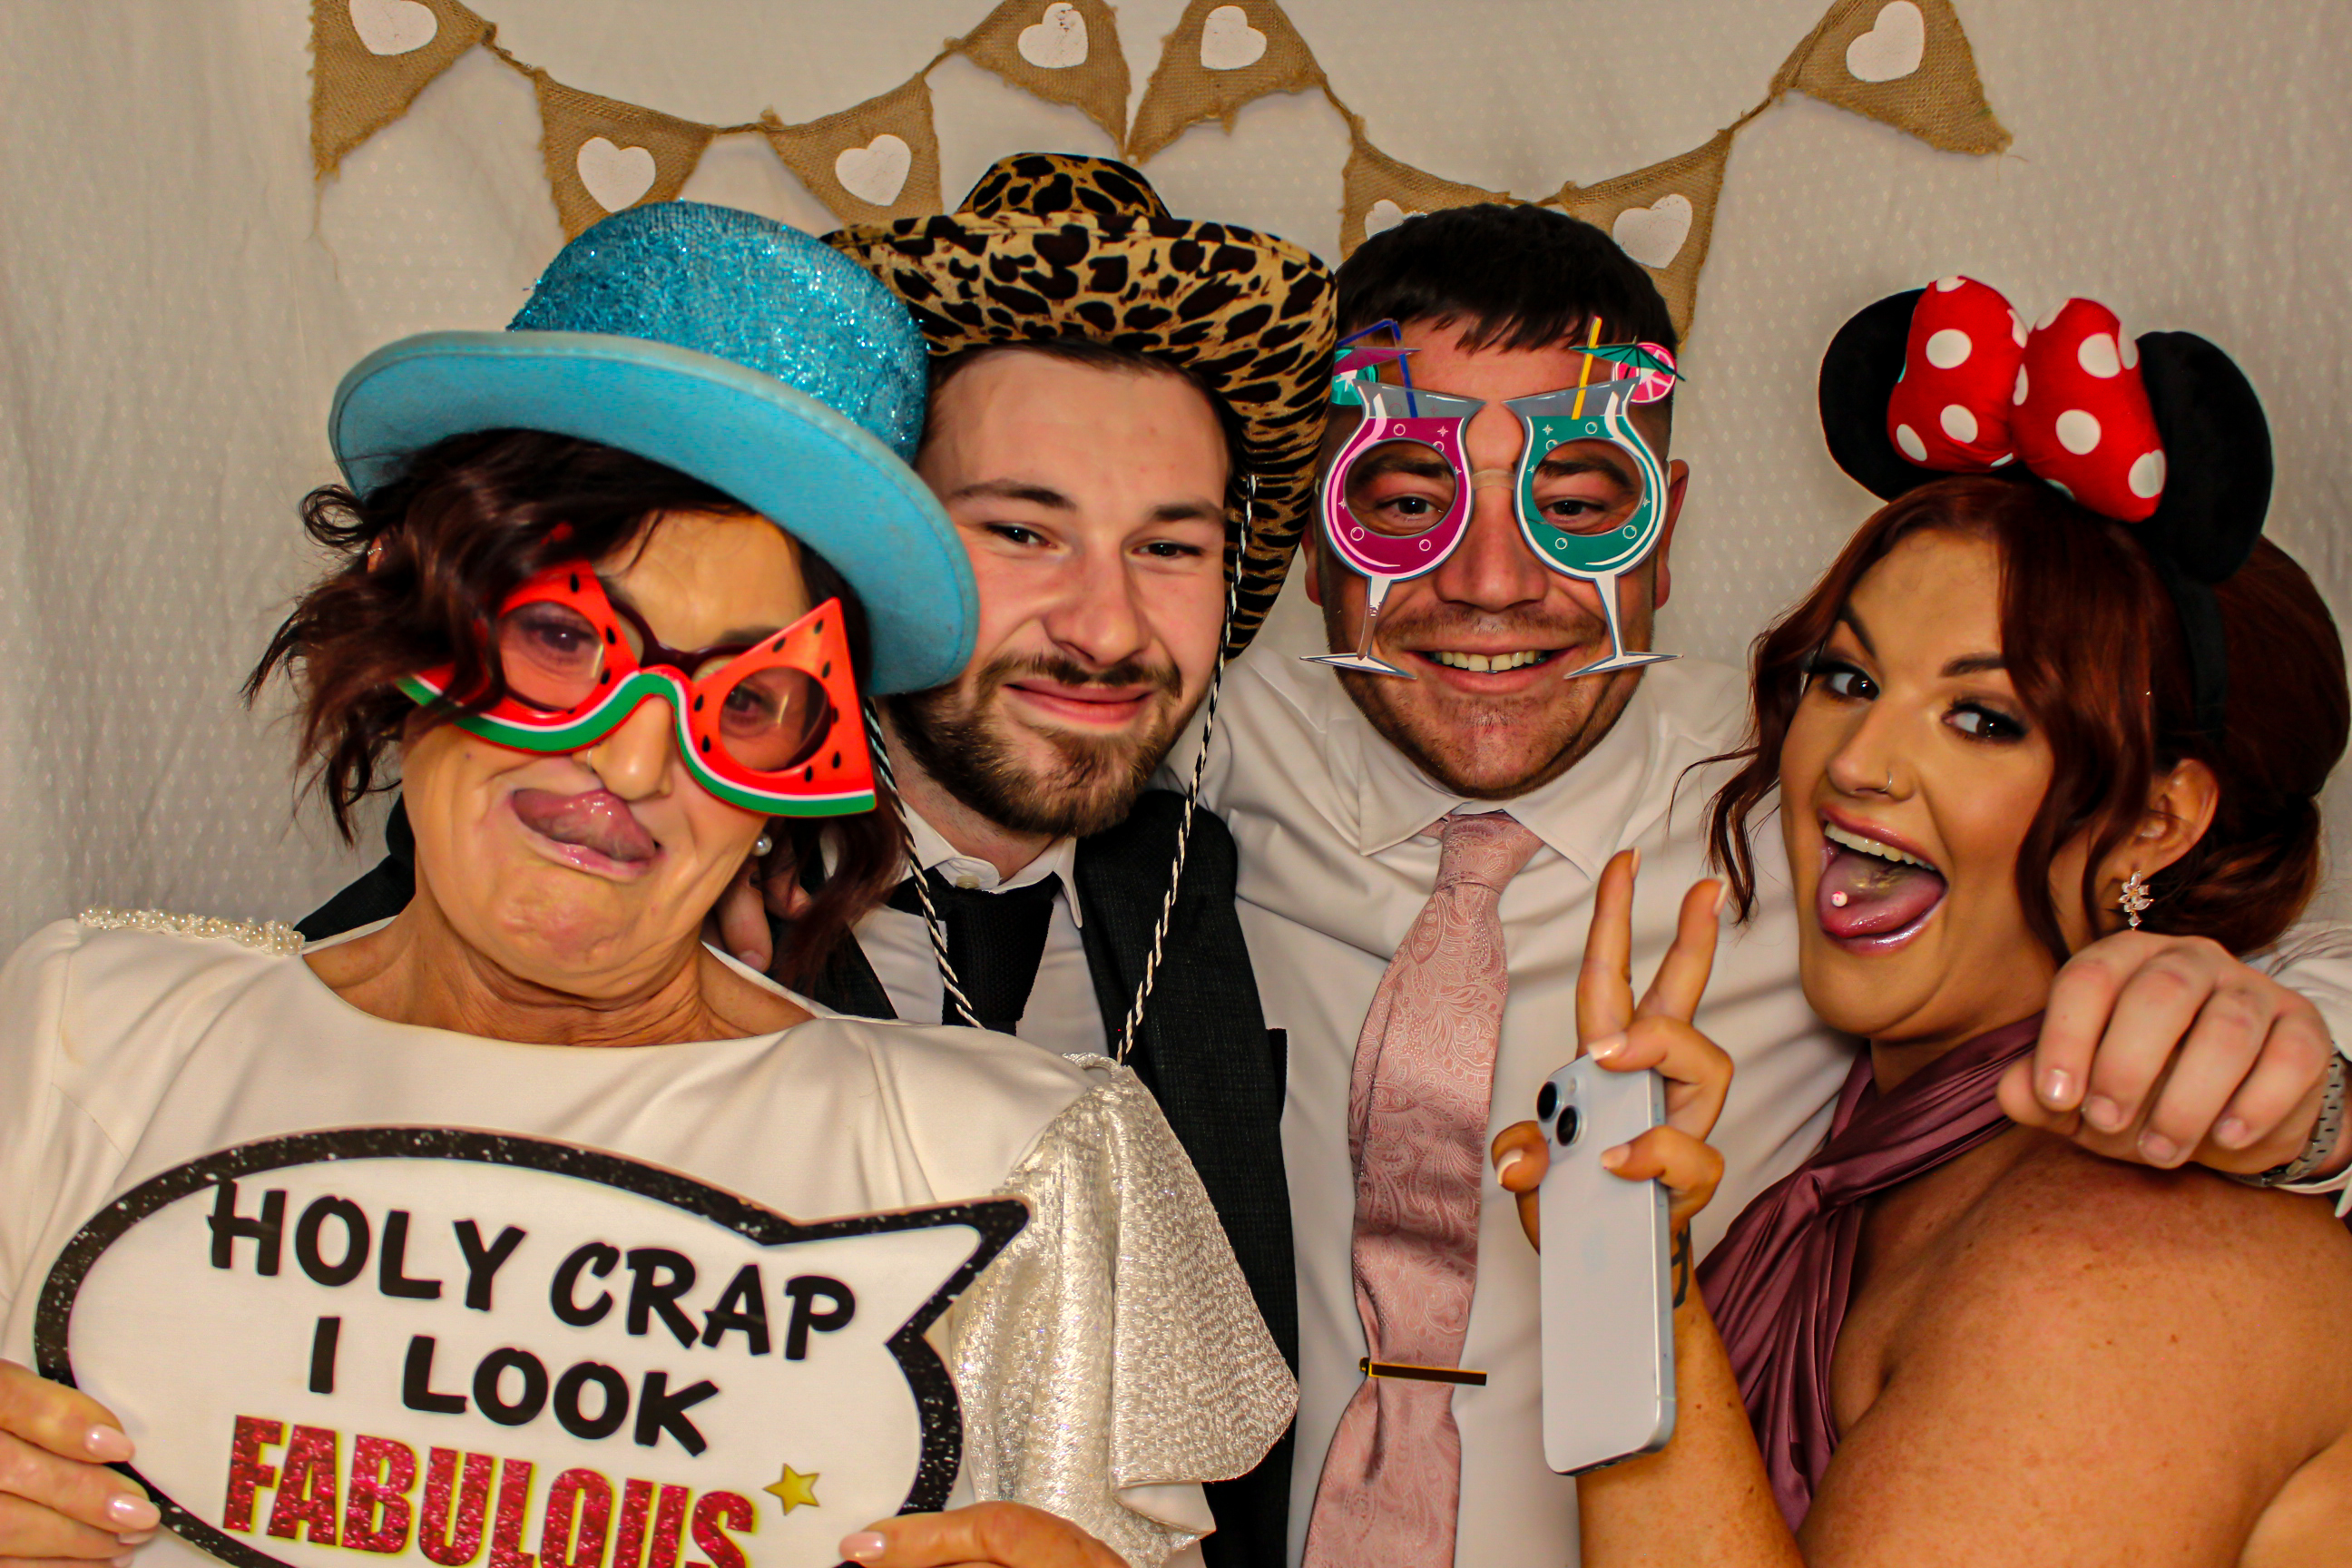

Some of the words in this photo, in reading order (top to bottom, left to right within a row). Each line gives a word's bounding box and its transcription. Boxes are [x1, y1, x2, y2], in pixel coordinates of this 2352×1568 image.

[207, 1180, 526, 1312] HOLY
[548, 1241, 857, 1361] CRAP
[309, 1315, 342, 1395] I
[402, 1334, 720, 1457] LOOK
[220, 1413, 760, 1568] FABULOUS
